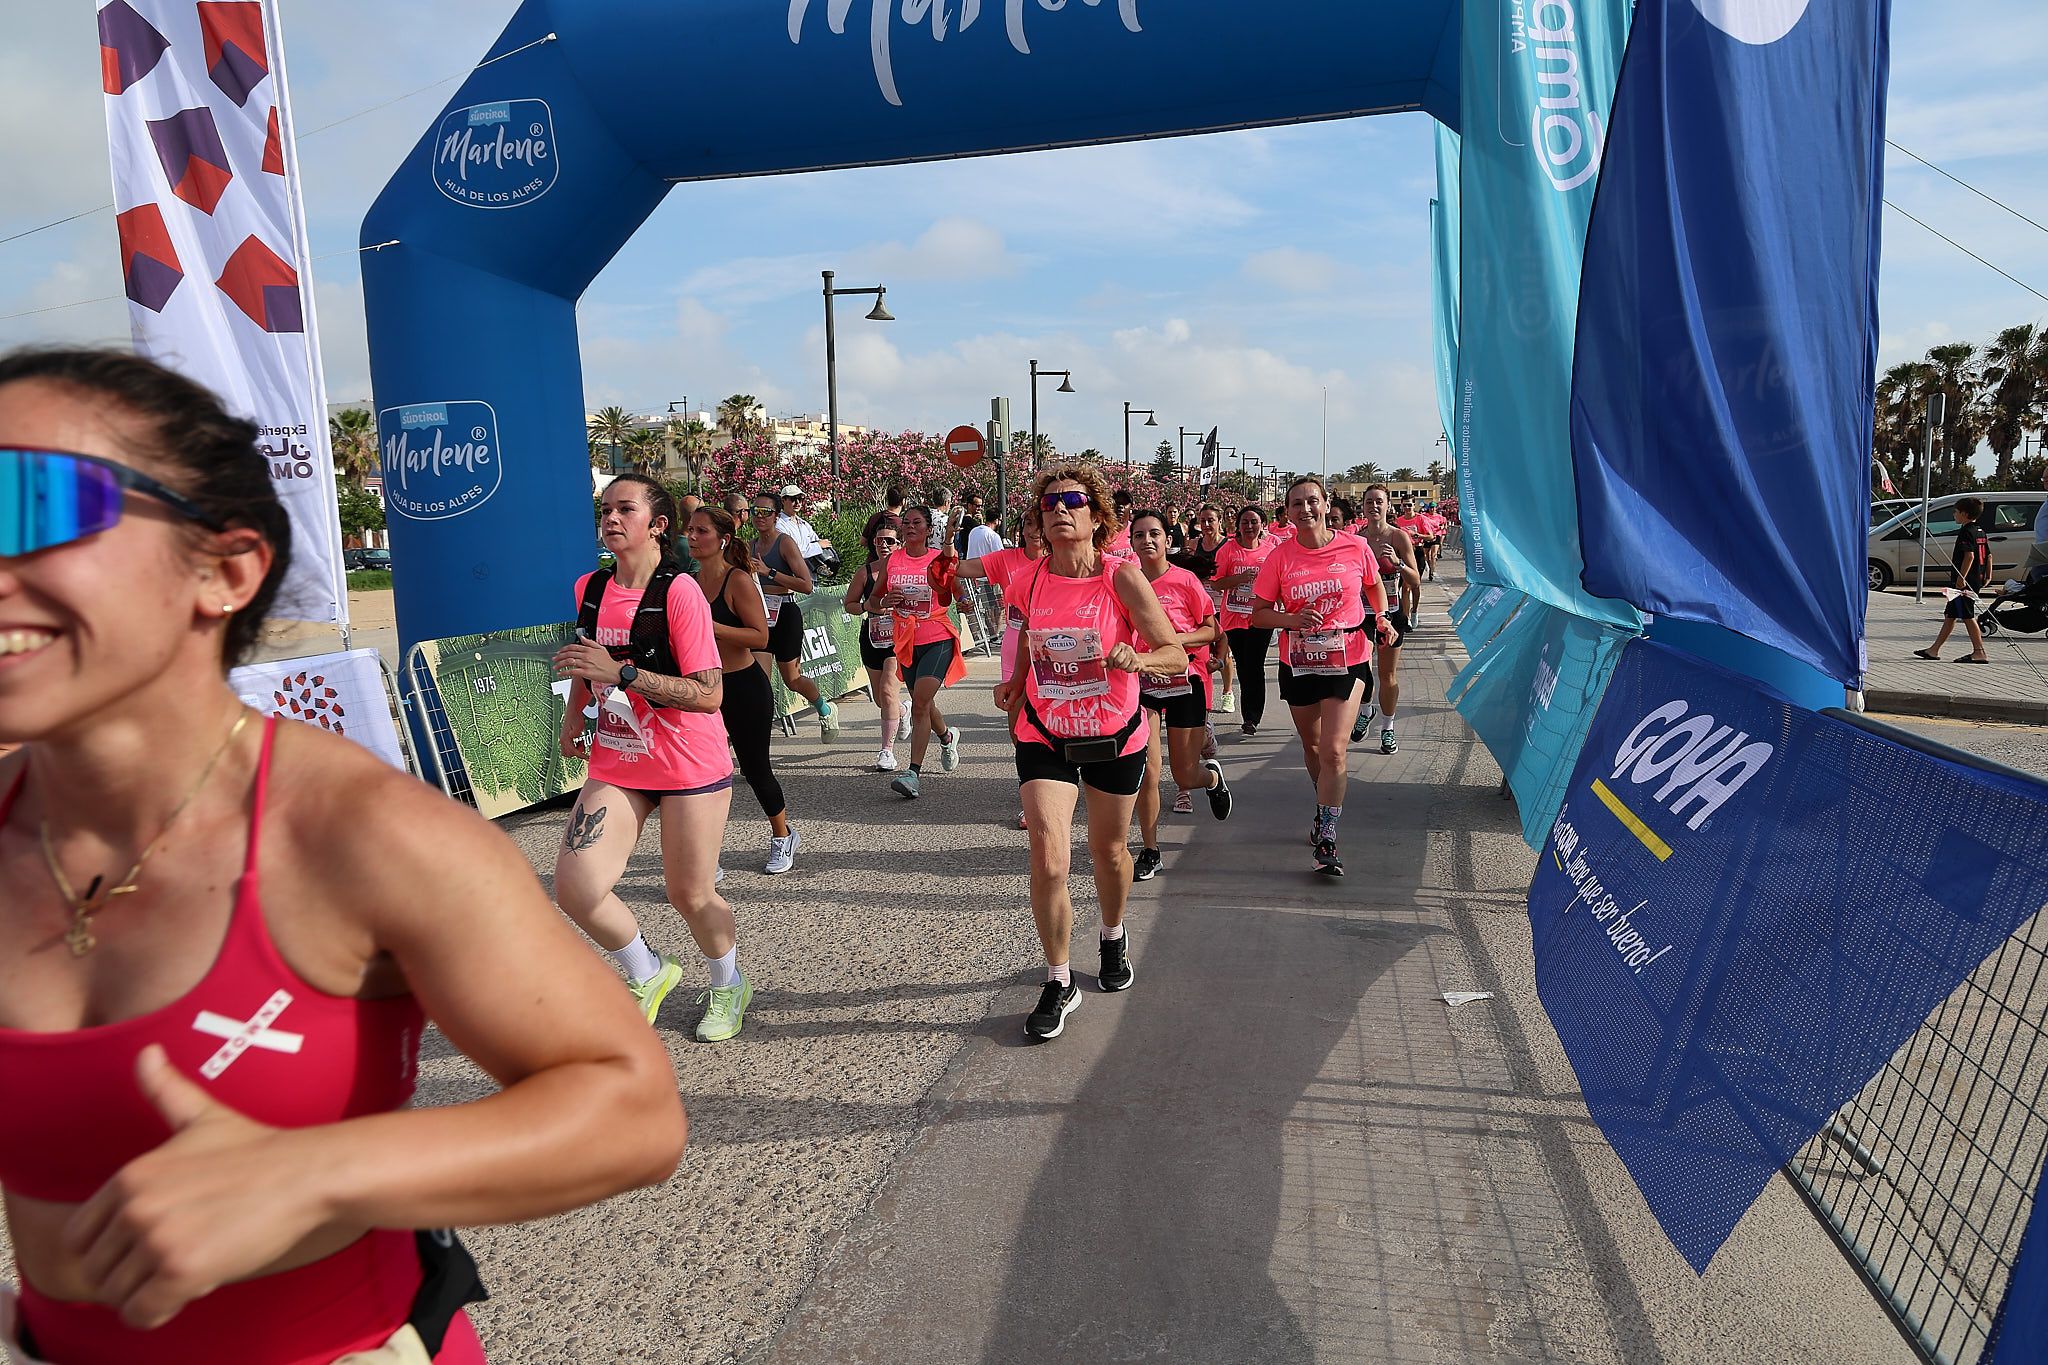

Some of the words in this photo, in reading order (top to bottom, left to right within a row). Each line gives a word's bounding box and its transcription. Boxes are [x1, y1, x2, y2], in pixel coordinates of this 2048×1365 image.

[441, 125, 547, 180] Marlene
[445, 179, 466, 197] HIJA
[470, 191, 484, 200] DE
[488, 192, 509, 202] LOS
[512, 178, 543, 199] ALPES
[386, 428, 490, 490] Marlene
[392, 489, 408, 508] HIJA
[410, 501, 422, 512] DE
[425, 502, 445, 512] LOS
[449, 485, 483, 508] ALPES
[1291, 578, 1343, 600] CARRERA
[1053, 661, 1079, 674] 016
[1306, 651, 1328, 661] 016
[473, 675, 497, 694] 1975
[1045, 709, 1101, 736] MUJER
[1610, 700, 1774, 831] GOYA
[1565, 876, 1604, 913] que
[1591, 894, 1620, 923] ser
[1606, 900, 1673, 974] bueno!
